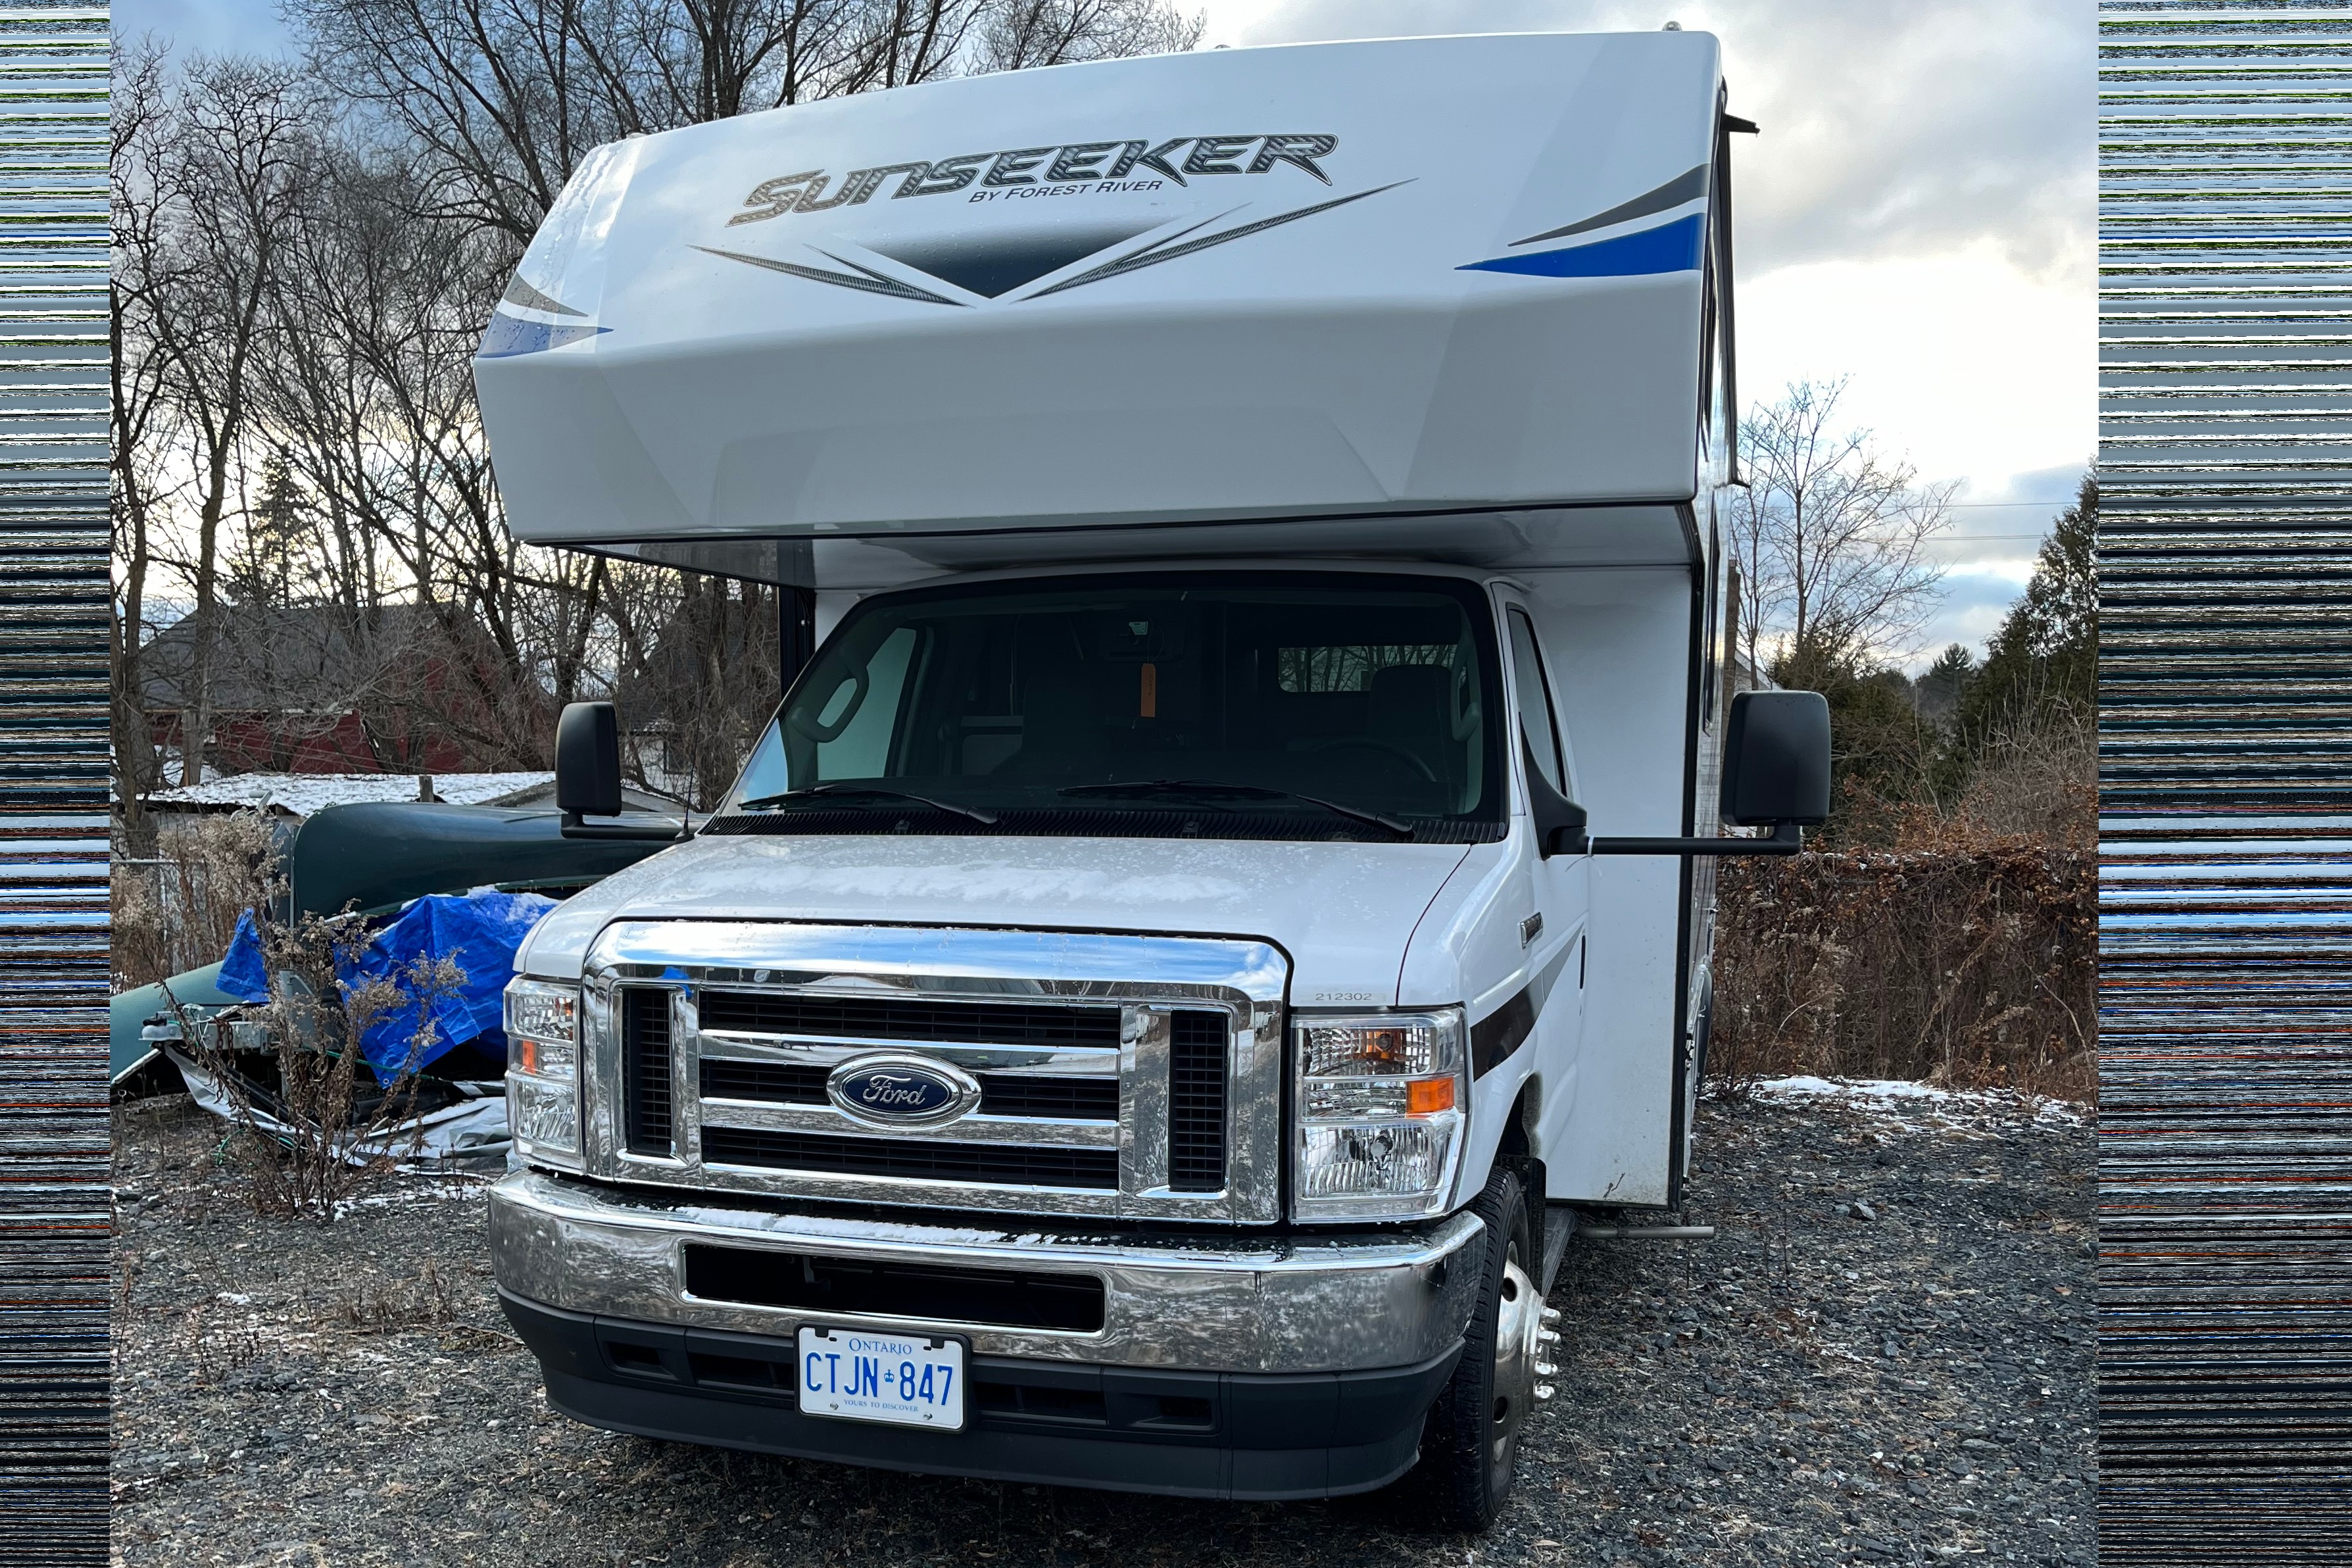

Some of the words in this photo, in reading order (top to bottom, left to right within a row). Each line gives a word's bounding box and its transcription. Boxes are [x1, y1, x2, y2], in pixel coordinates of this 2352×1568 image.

[725, 134, 1339, 228] SUNSEEKER
[969, 190, 1002, 203] BY
[1004, 184, 1093, 200] FOREST
[1096, 180, 1164, 193] RIVER
[1315, 992, 1373, 1001] 212302
[862, 1074, 927, 1106] Ford
[848, 1338, 912, 1356] ONTARIO
[806, 1352, 878, 1398] CTJN
[900, 1361, 953, 1406] 847
[882, 1402, 919, 1412] DISCOVER
